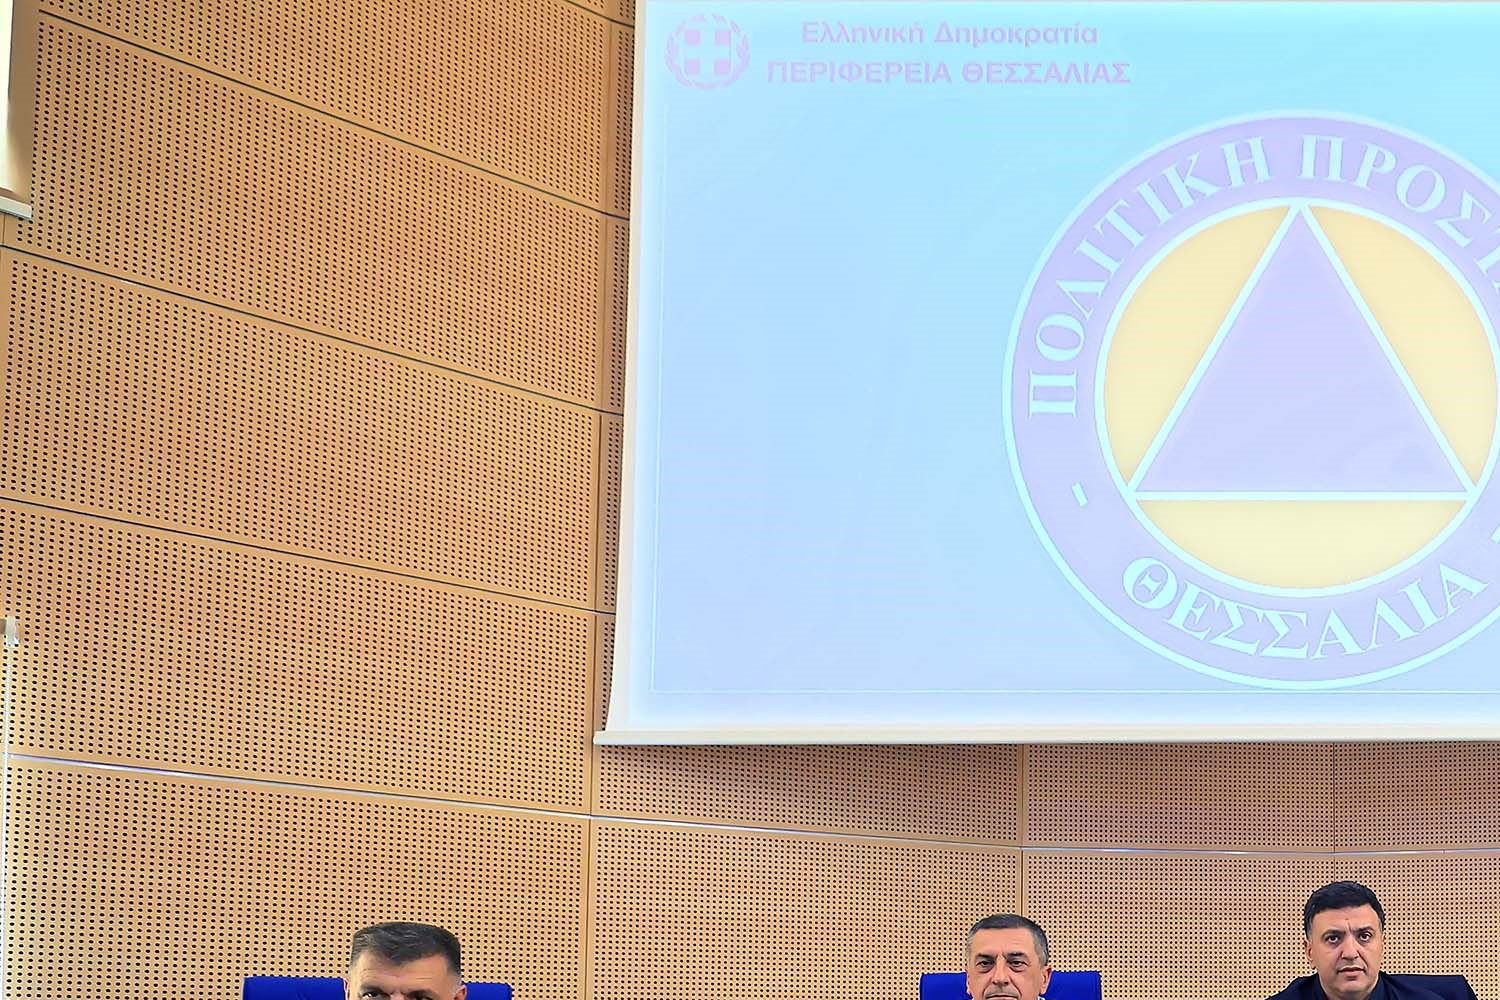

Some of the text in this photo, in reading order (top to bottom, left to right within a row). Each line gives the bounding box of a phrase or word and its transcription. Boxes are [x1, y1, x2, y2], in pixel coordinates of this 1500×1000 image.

[801, 20, 1098, 47] Ελληνική Δημοκρατία
[767, 60, 1132, 84] ΠΕΡΙΦΕΡΕΙΑ ΘΕΣΣΑΛΙΑΣ
[1028, 135, 1272, 419] ΠΟΛΙΤΙΚΗ
[1121, 555, 1490, 661] ΘΕΣΣΑΛΙΑ
